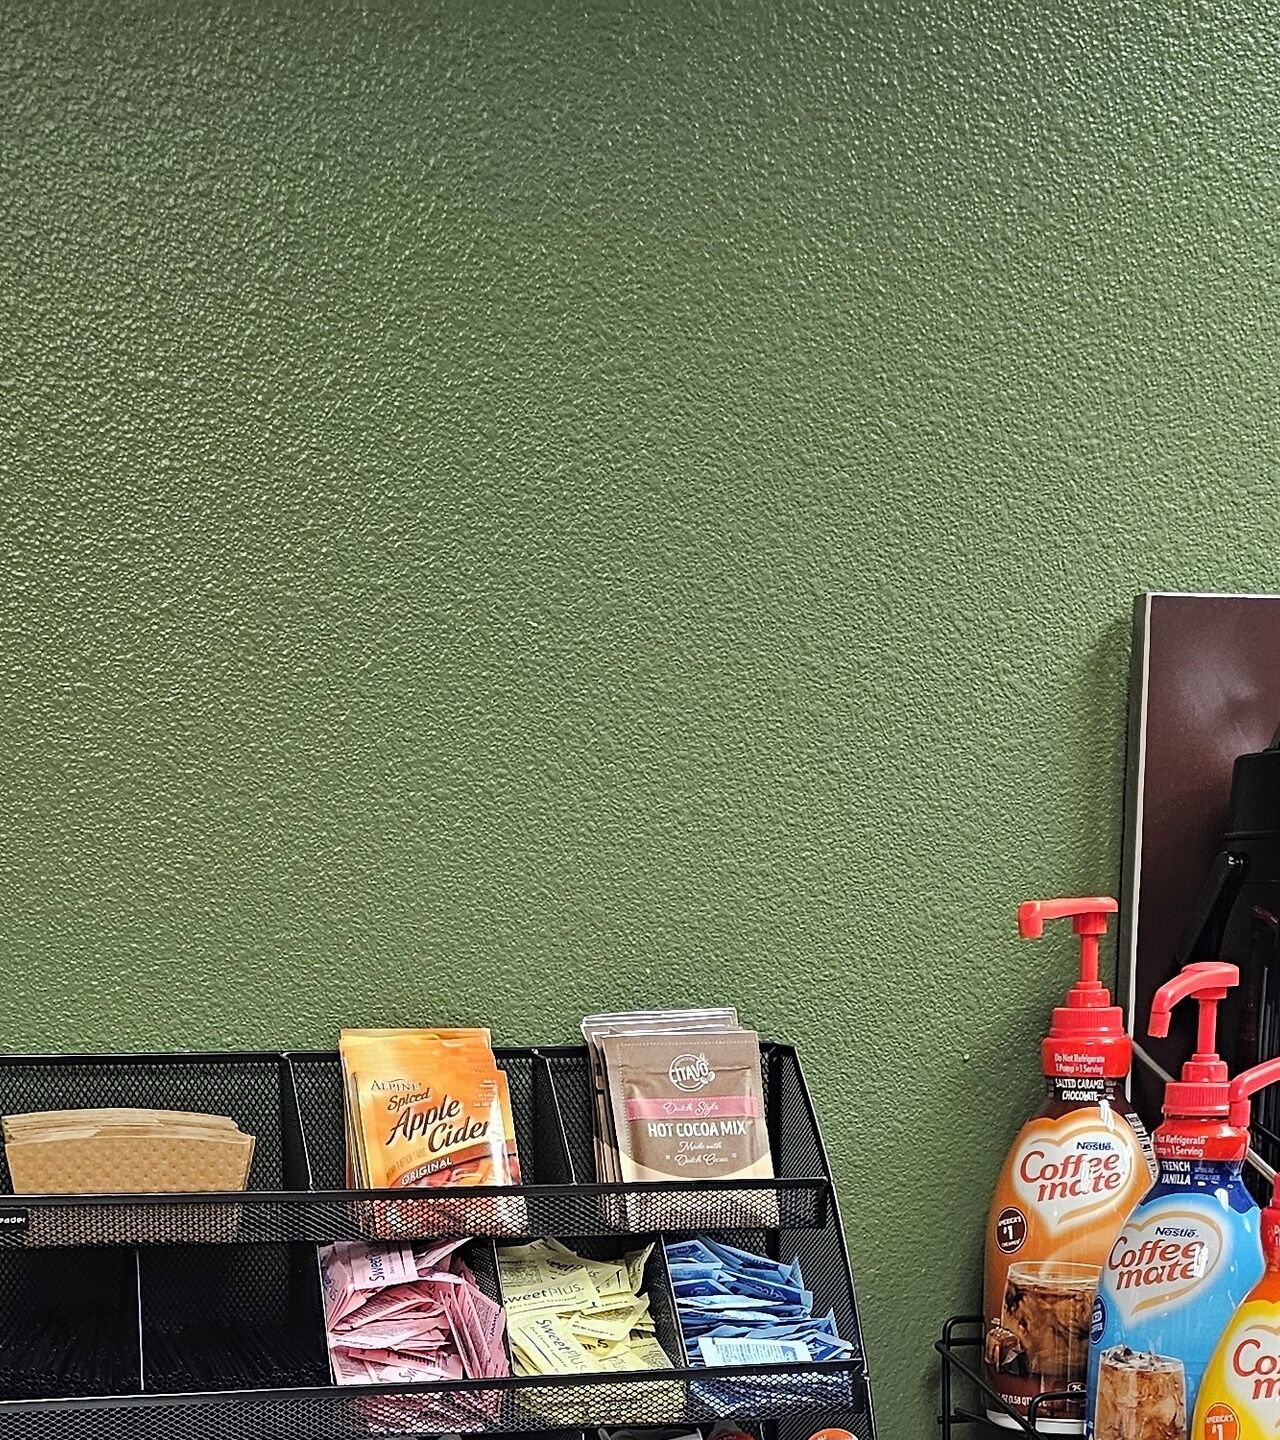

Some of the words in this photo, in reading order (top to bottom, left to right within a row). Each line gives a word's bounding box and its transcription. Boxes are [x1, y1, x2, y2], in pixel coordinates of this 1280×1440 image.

[1062, 1054, 1074, 1062] Not
[1074, 1054, 1105, 1066] Refrigerate
[1055, 1078, 1076, 1089] SALTED
[1077, 1079, 1104, 1089] CARAMEL
[387, 1088, 431, 1112] Spiced
[1062, 1090, 1098, 1101] CHOCOLATE
[662, 1102, 693, 1114] Dutch
[695, 1101, 719, 1117] Style
[385, 1094, 460, 1145] Apple
[428, 1116, 489, 1152] Cider
[648, 1123, 673, 1138] HOT
[676, 1122, 719, 1137] COCOA
[720, 1121, 747, 1136] MIX
[1165, 1134, 1206, 1146] Refrigerate
[1175, 1146, 1203, 1157] Serving
[401, 1157, 453, 1185] ORIGINAL
[1020, 1150, 1120, 1183] Coffee
[1161, 1161, 1190, 1172] FRENCH
[1037, 1172, 1121, 1202] mate
[1161, 1174, 1191, 1185] VANILLA
[1108, 1236, 1205, 1270] Coffee
[1116, 1259, 1205, 1291] mate
